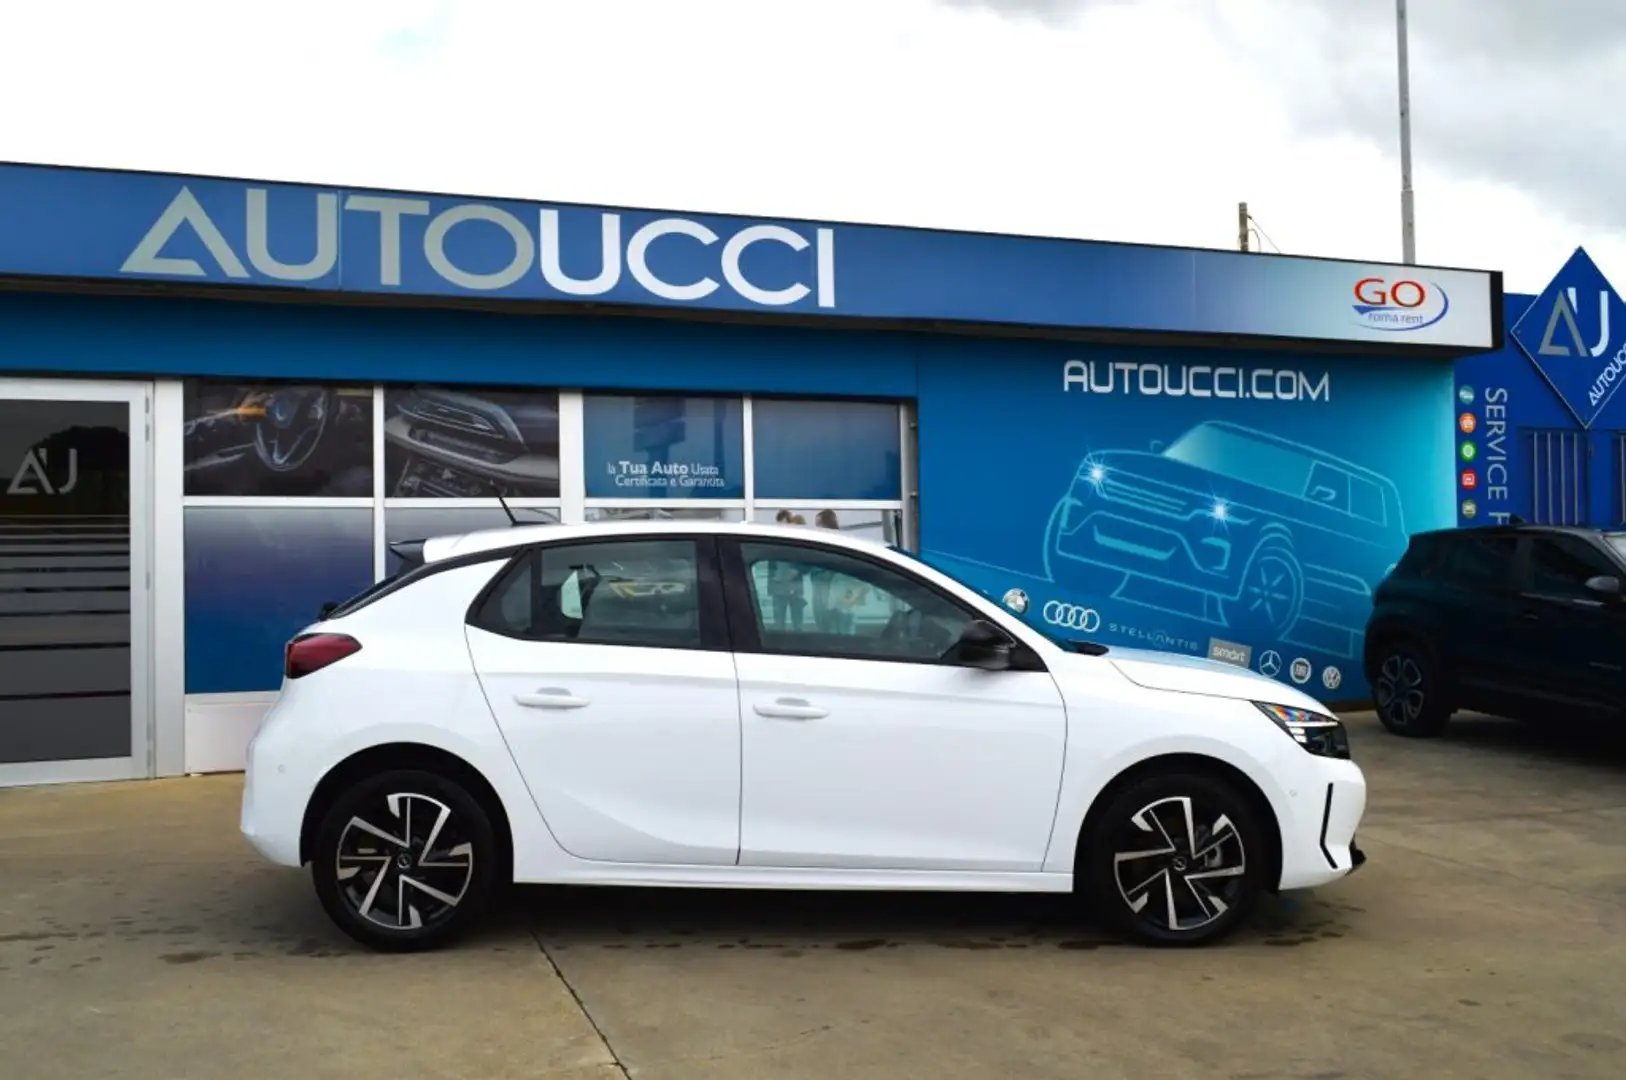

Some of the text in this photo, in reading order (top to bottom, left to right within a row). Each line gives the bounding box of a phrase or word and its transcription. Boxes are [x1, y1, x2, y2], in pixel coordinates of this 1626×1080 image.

[120, 186, 836, 309] AUTOUCCI
[1354, 277, 1425, 308] GO
[1401, 315, 1423, 325] rent
[1063, 360, 1330, 402] AUTOUCCI.COM
[1485, 387, 1508, 500] SERVICE
[619, 461, 648, 475] Tua
[651, 461, 688, 475] Auto
[670, 478, 677, 486] e
[1212, 645, 1245, 662] smart
